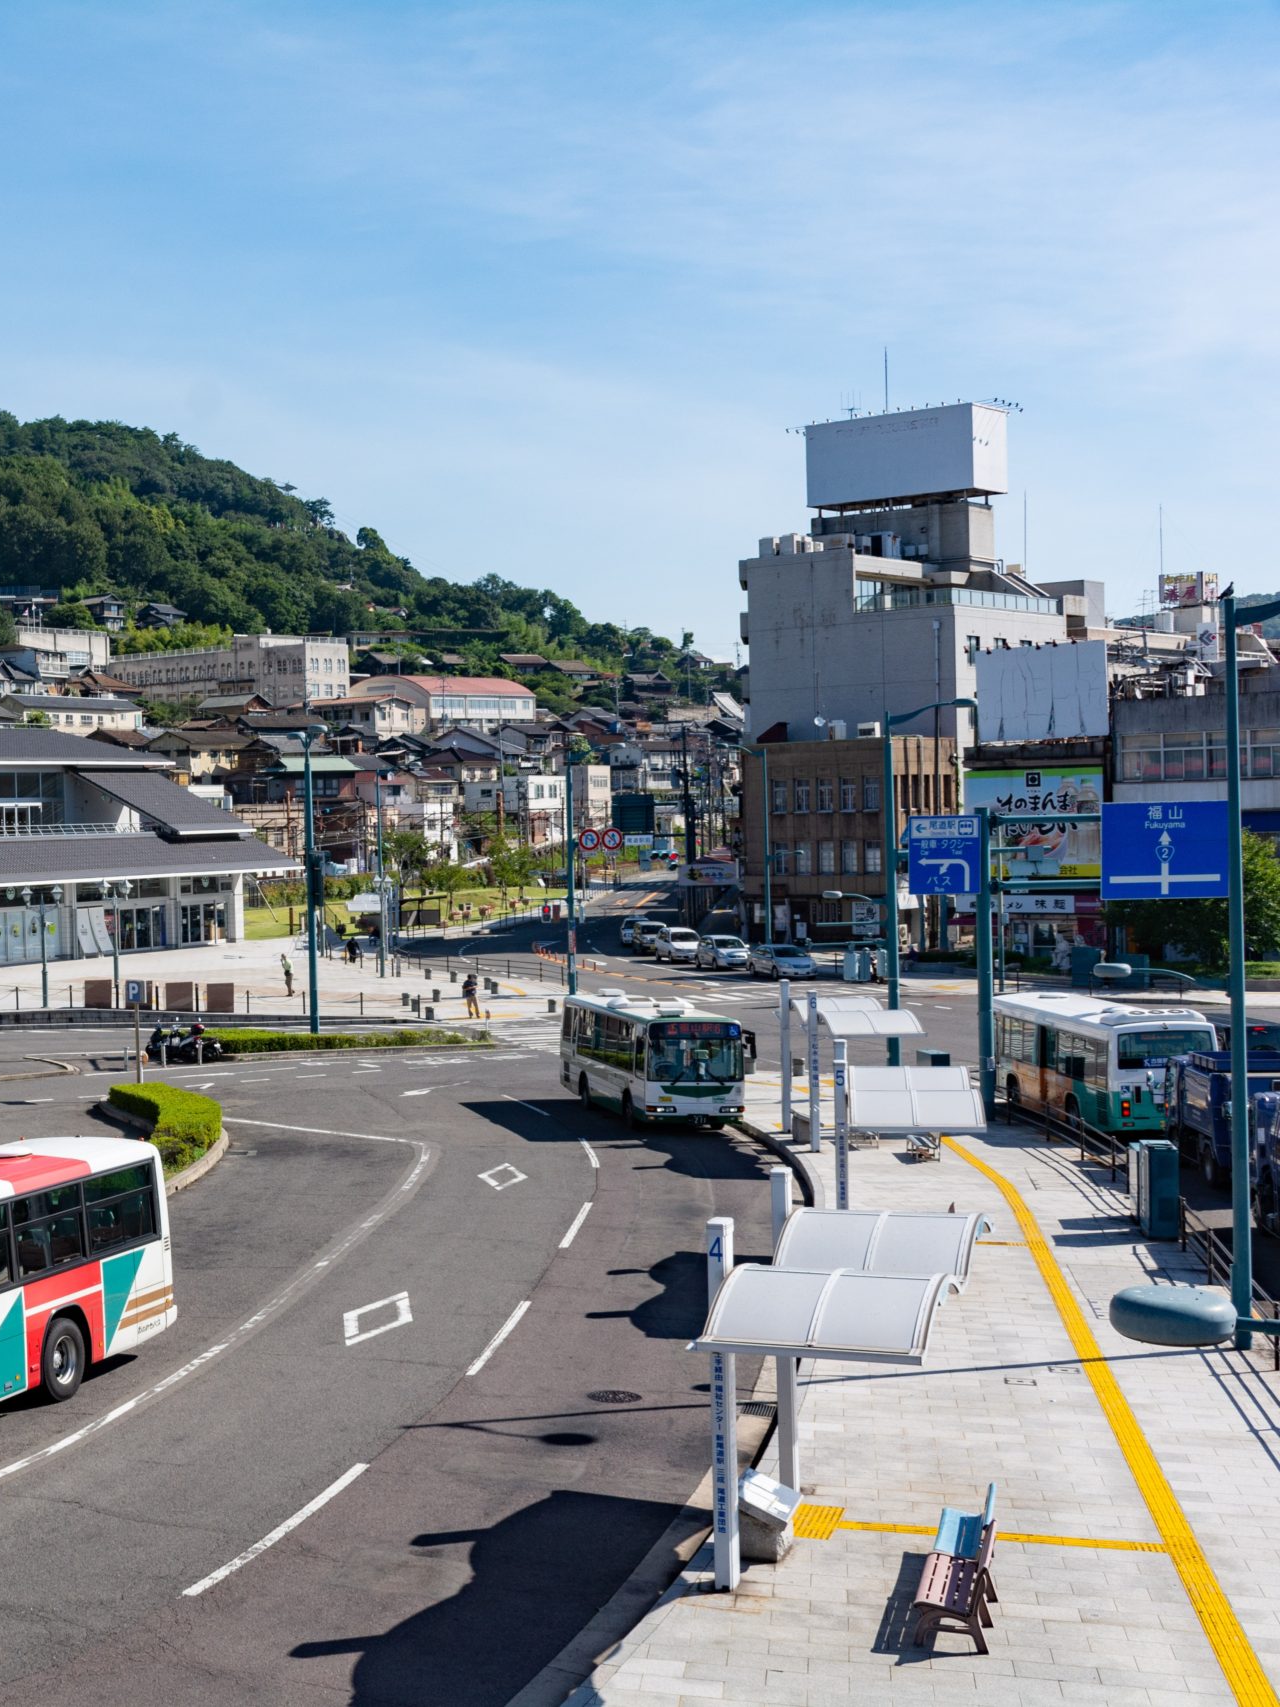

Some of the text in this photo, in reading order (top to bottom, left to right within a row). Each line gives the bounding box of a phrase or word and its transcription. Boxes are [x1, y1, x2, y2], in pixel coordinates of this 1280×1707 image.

[997, 791, 1070, 812] そのまんま
[1147, 805, 1183, 820] 福山
[1144, 820, 1186, 830] Fukuyama
[1161, 848, 1169, 859] 2
[926, 876, 952, 886] バス
[128, 982, 139, 1000] P
[810, 997, 817, 1009] 6
[836, 1069, 845, 1087] 5
[708, 1236, 723, 1263] 4
